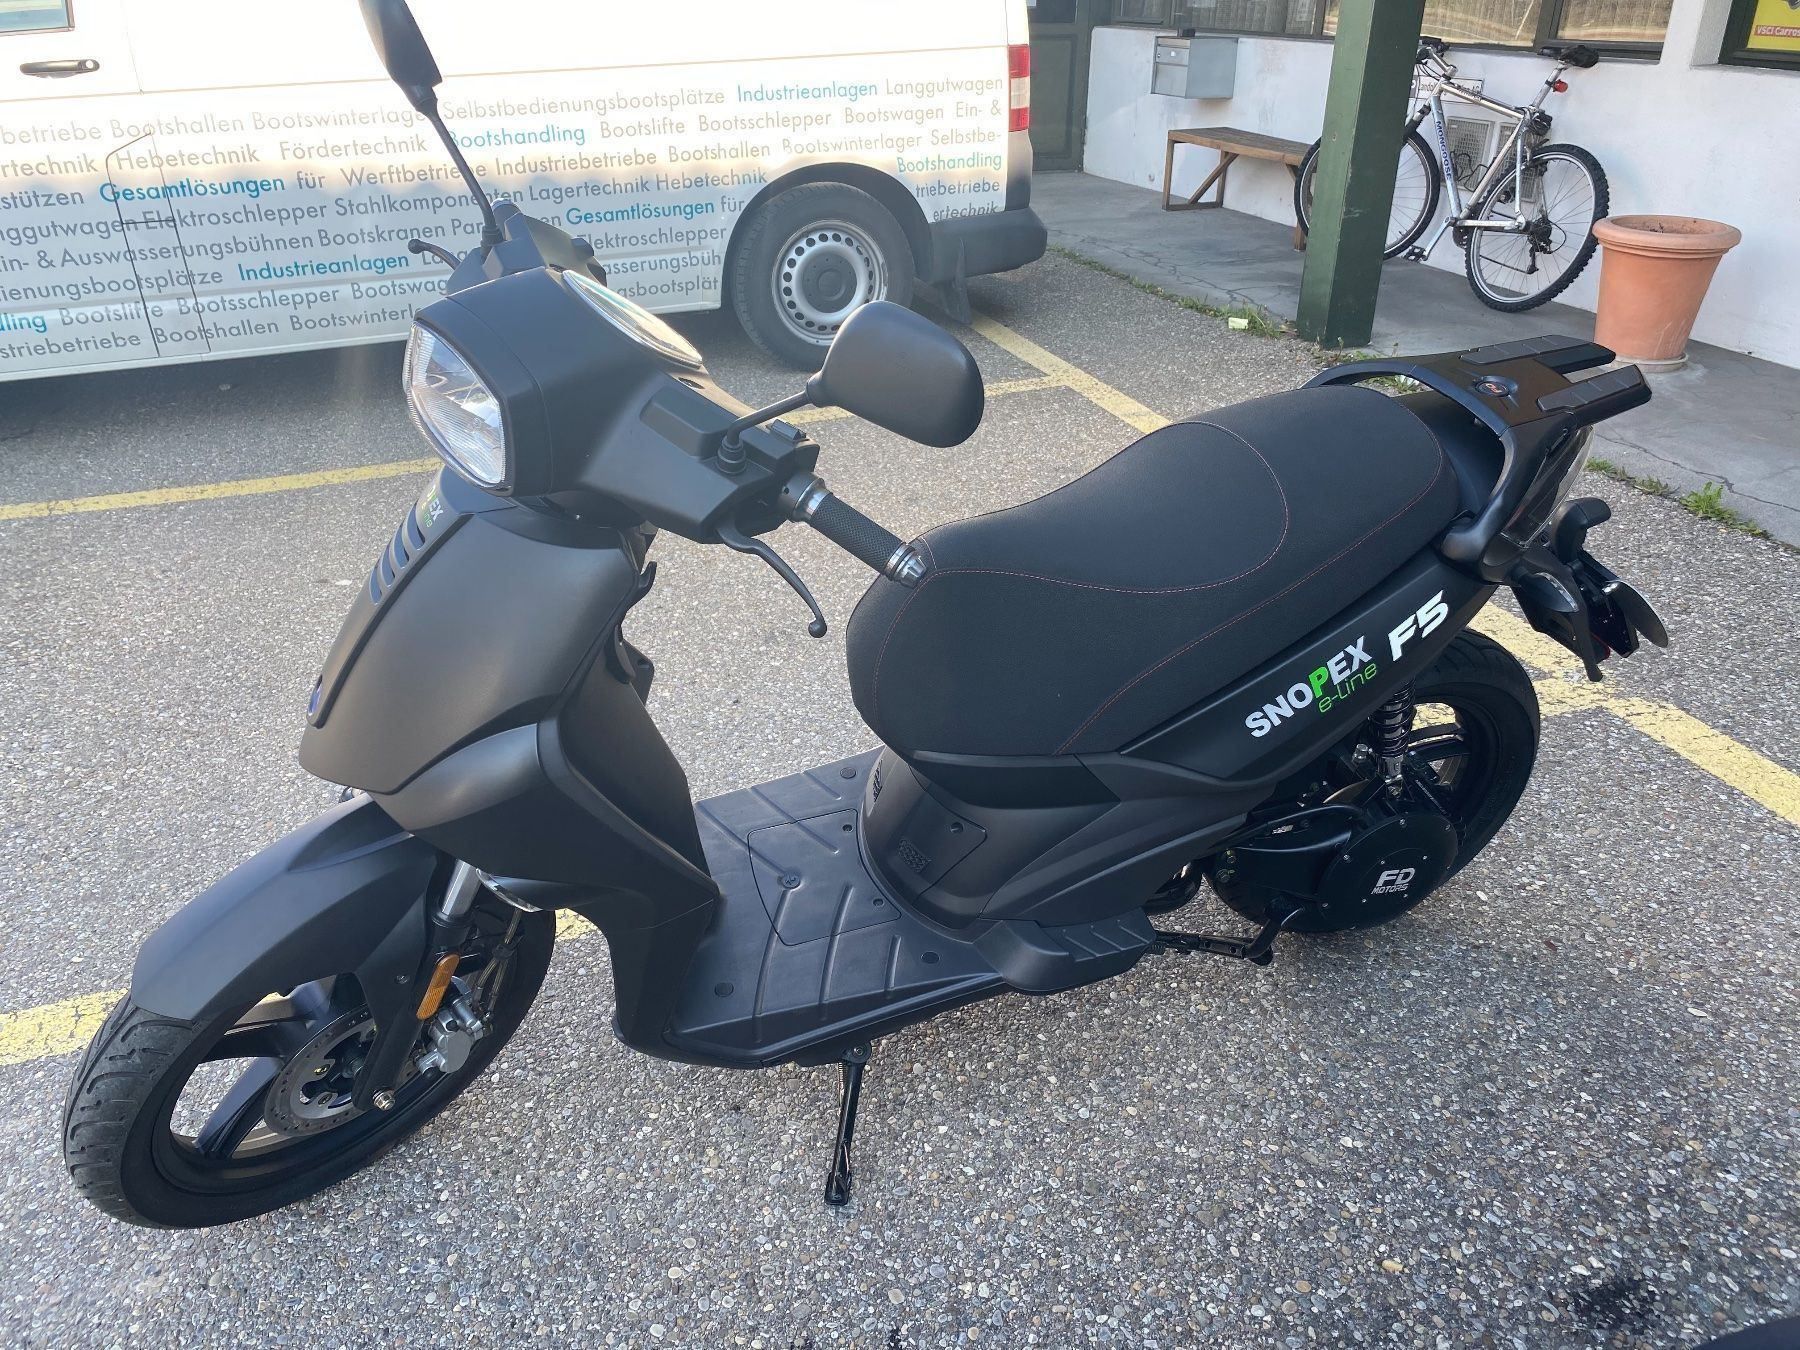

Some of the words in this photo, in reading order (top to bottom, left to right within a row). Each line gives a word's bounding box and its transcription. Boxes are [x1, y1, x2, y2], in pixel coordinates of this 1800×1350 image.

[110, 112, 244, 139] Bootshallen
[252, 105, 425, 131] Bootswinterlage
[443, 88, 725, 120] Selbstbedienungsbootsplätze
[737, 80, 878, 102] Industrieanlagen
[886, 76, 1003, 99] Langgutwagen
[116, 143, 260, 170] Hebetechnik
[279, 134, 428, 160] Fördertechnik
[600, 116, 686, 139] Bootslifte
[699, 107, 832, 132] Bootsschlepper
[845, 105, 944, 124] Bootswagen
[956, 100, 982, 118] Ein-
[990, 99, 1002, 116] &
[1436, 121, 1452, 180] MONGOOSE
[0, 190, 84, 210] stützen
[99, 176, 285, 202] Gesamtlösungen
[296, 170, 325, 190] für
[340, 160, 487, 187] Werftbetriee
[495, 147, 657, 176] Industriebetriebe
[668, 138, 770, 163] Bootshallen
[782, 131, 922, 155] Bootswinterlager
[931, 126, 1001, 146] Selbstbe-
[897, 152, 1002, 174] Bootshandling
[916, 176, 1000, 198] triebetriebe
[142, 203, 327, 230] Elektroschlepper
[529, 175, 650, 204] Lagertechnik
[656, 168, 767, 192] Hebetechnik
[0, 257, 29, 273] in-
[37, 249, 56, 269] &
[61, 232, 313, 268] Auswasserungsbühnen
[318, 224, 445, 247] Bootskranen
[566, 200, 714, 225] Gesamtlösungen
[721, 195, 745, 212] für
[577, 226, 727, 251] lektroschlepper
[238, 253, 409, 281] Industrieanlagen
[154, 318, 279, 344] Bootshallen
[290, 303, 421, 331] Bootswinterl
[177, 288, 339, 316] Bootsschlepper
[1388, 590, 1448, 661] F5
[1245, 635, 1372, 738] SNOPEX
[1370, 883, 1409, 895] MOTORS
[1376, 867, 1415, 887] FD
